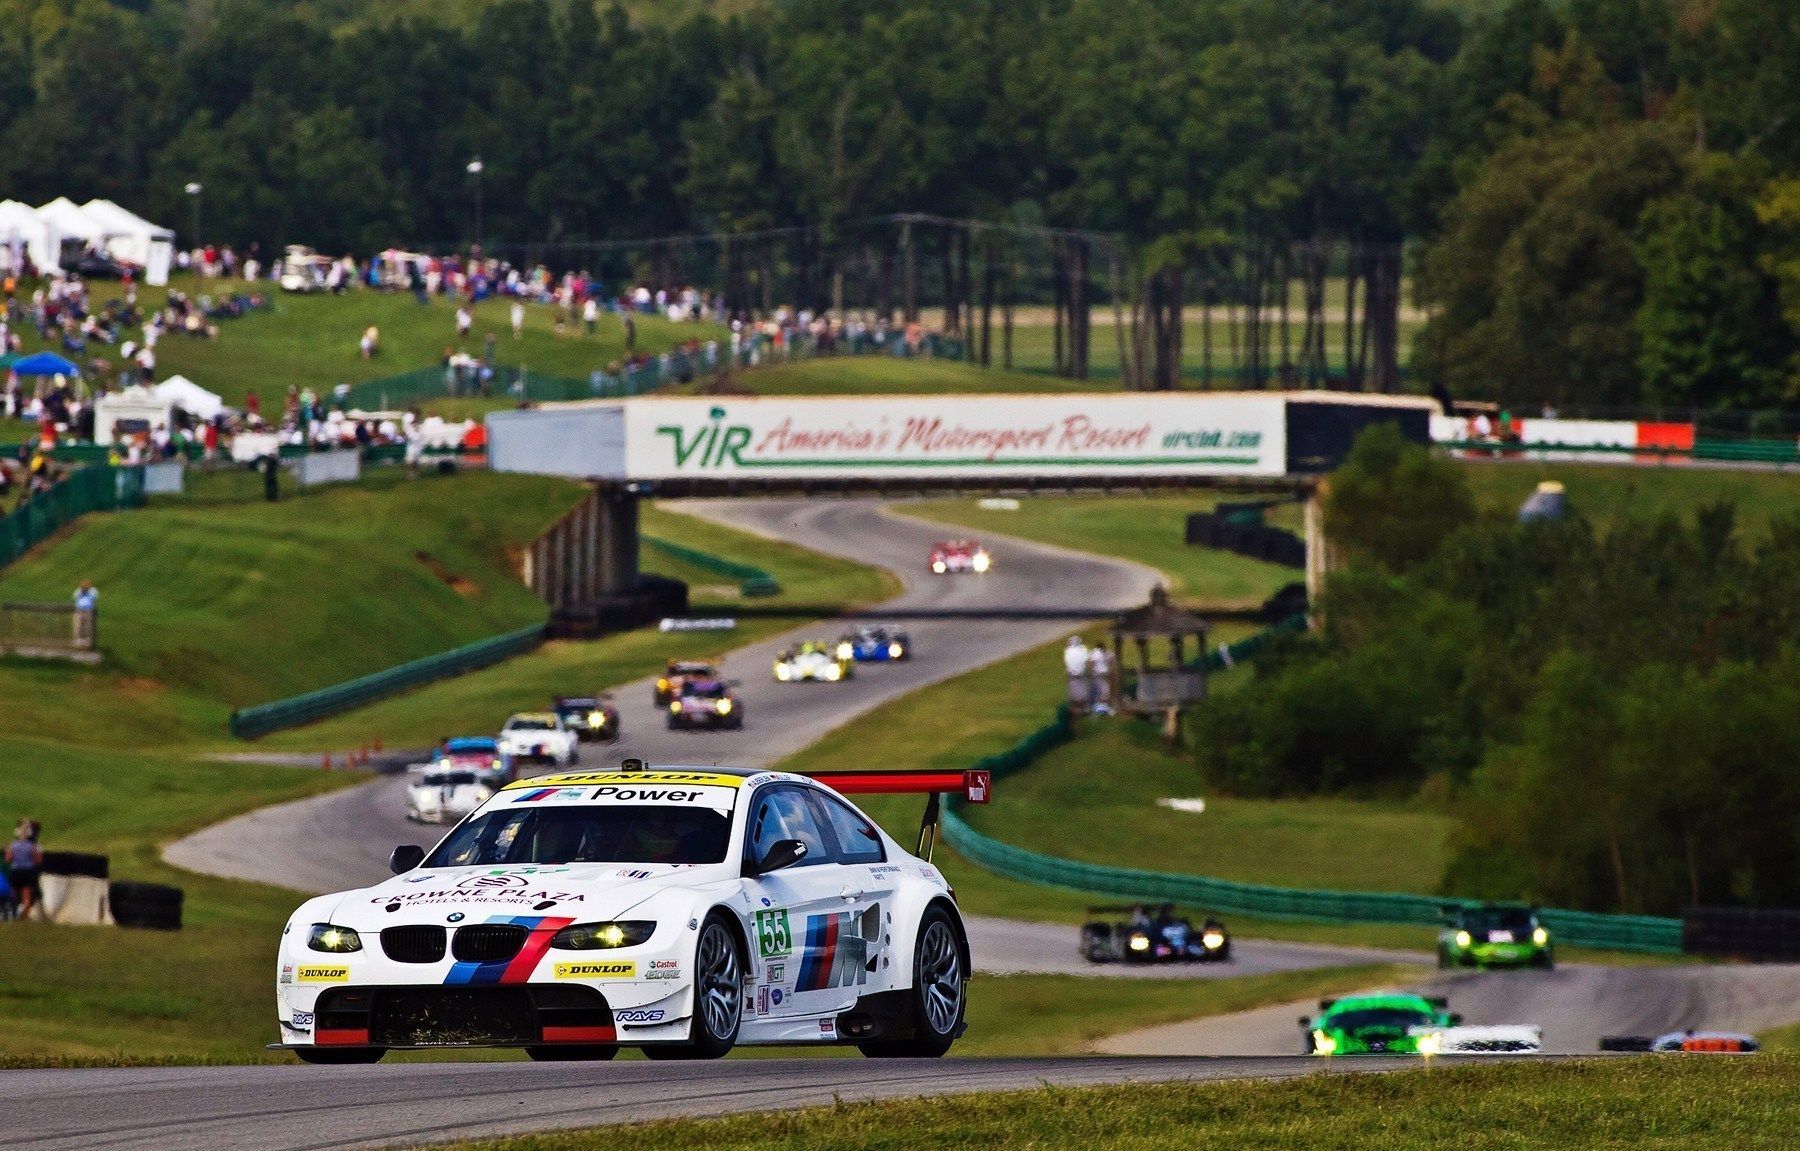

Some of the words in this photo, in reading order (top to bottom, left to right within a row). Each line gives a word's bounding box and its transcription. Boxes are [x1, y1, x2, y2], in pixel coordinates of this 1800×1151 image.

[754, 416, 891, 452] America's
[896, 415, 1054, 463] Motorsport
[1056, 414, 1152, 451] Resort
[591, 787, 704, 802] Power
[371, 889, 490, 904] CROWNE
[498, 889, 585, 902] PLAZA
[406, 898, 457, 906] HOTELS
[475, 897, 533, 905] RESORTS
[762, 911, 788, 954] 55
[569, 965, 633, 974] DUNLOP
[656, 960, 679, 969] Castrol
[304, 969, 347, 977] DUNLOP
[616, 1009, 666, 1021] RAYS
